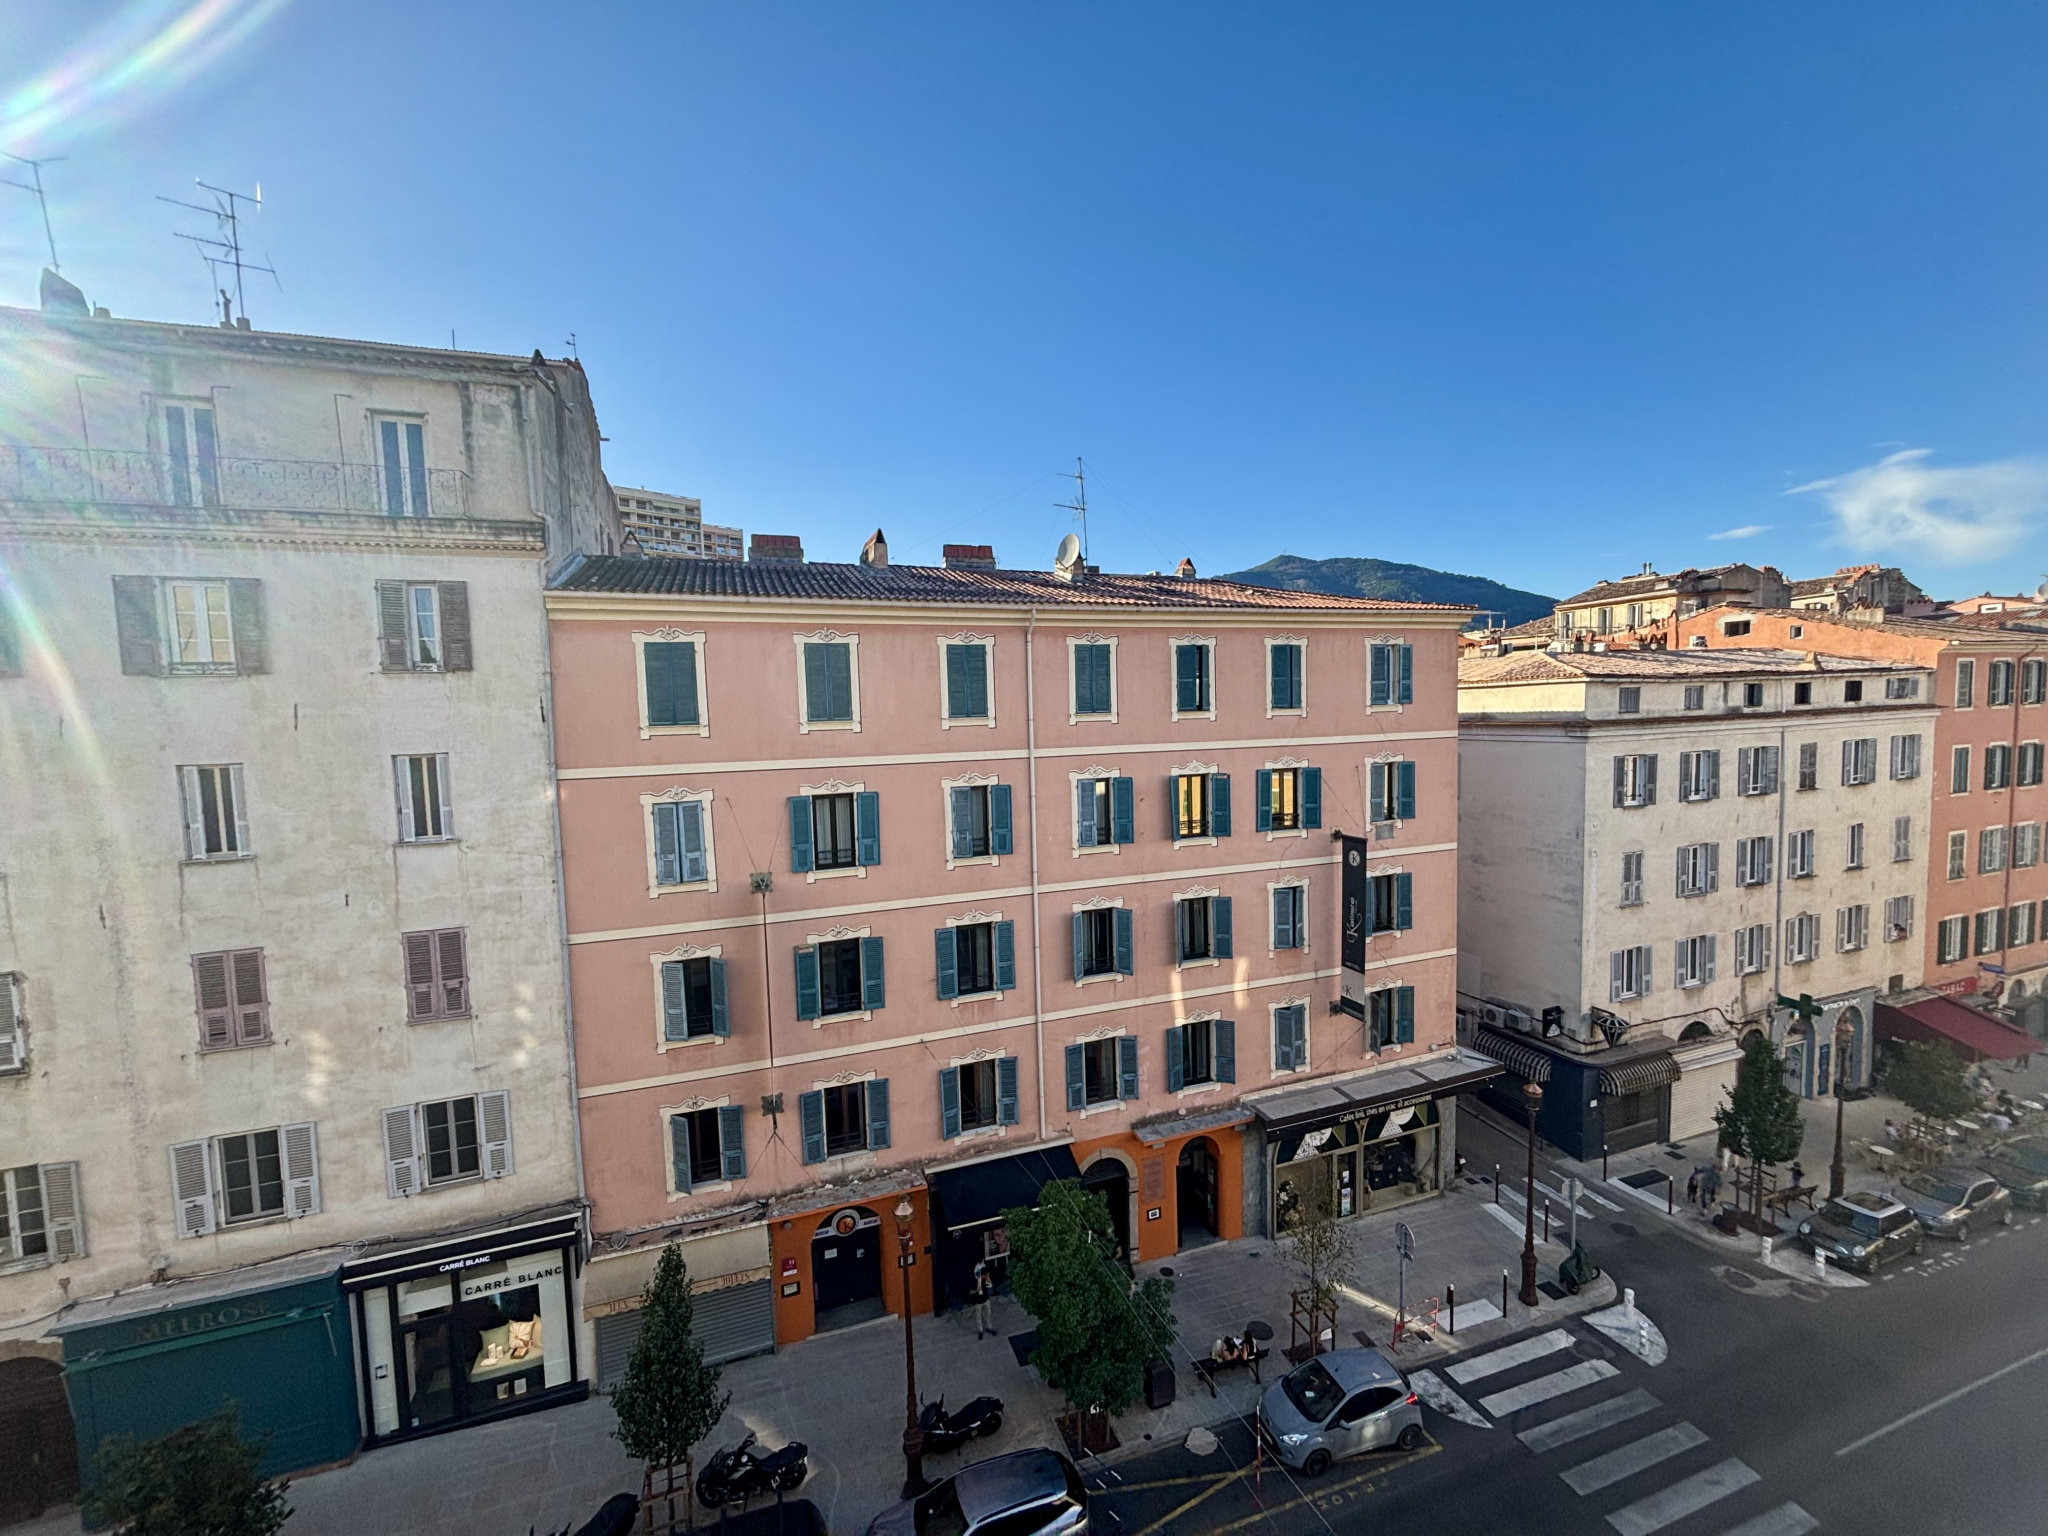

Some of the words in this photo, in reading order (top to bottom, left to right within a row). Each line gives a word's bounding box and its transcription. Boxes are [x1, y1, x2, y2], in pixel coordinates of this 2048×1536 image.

[1942, 981, 1966, 994] TABAC
[439, 1260, 465, 1272] CARRÉ
[465, 1255, 491, 1267] BLANC
[465, 1276, 511, 1296] CARRÉ
[518, 1266, 563, 1284] BLANC
[132, 1300, 273, 1344] MELROSE
